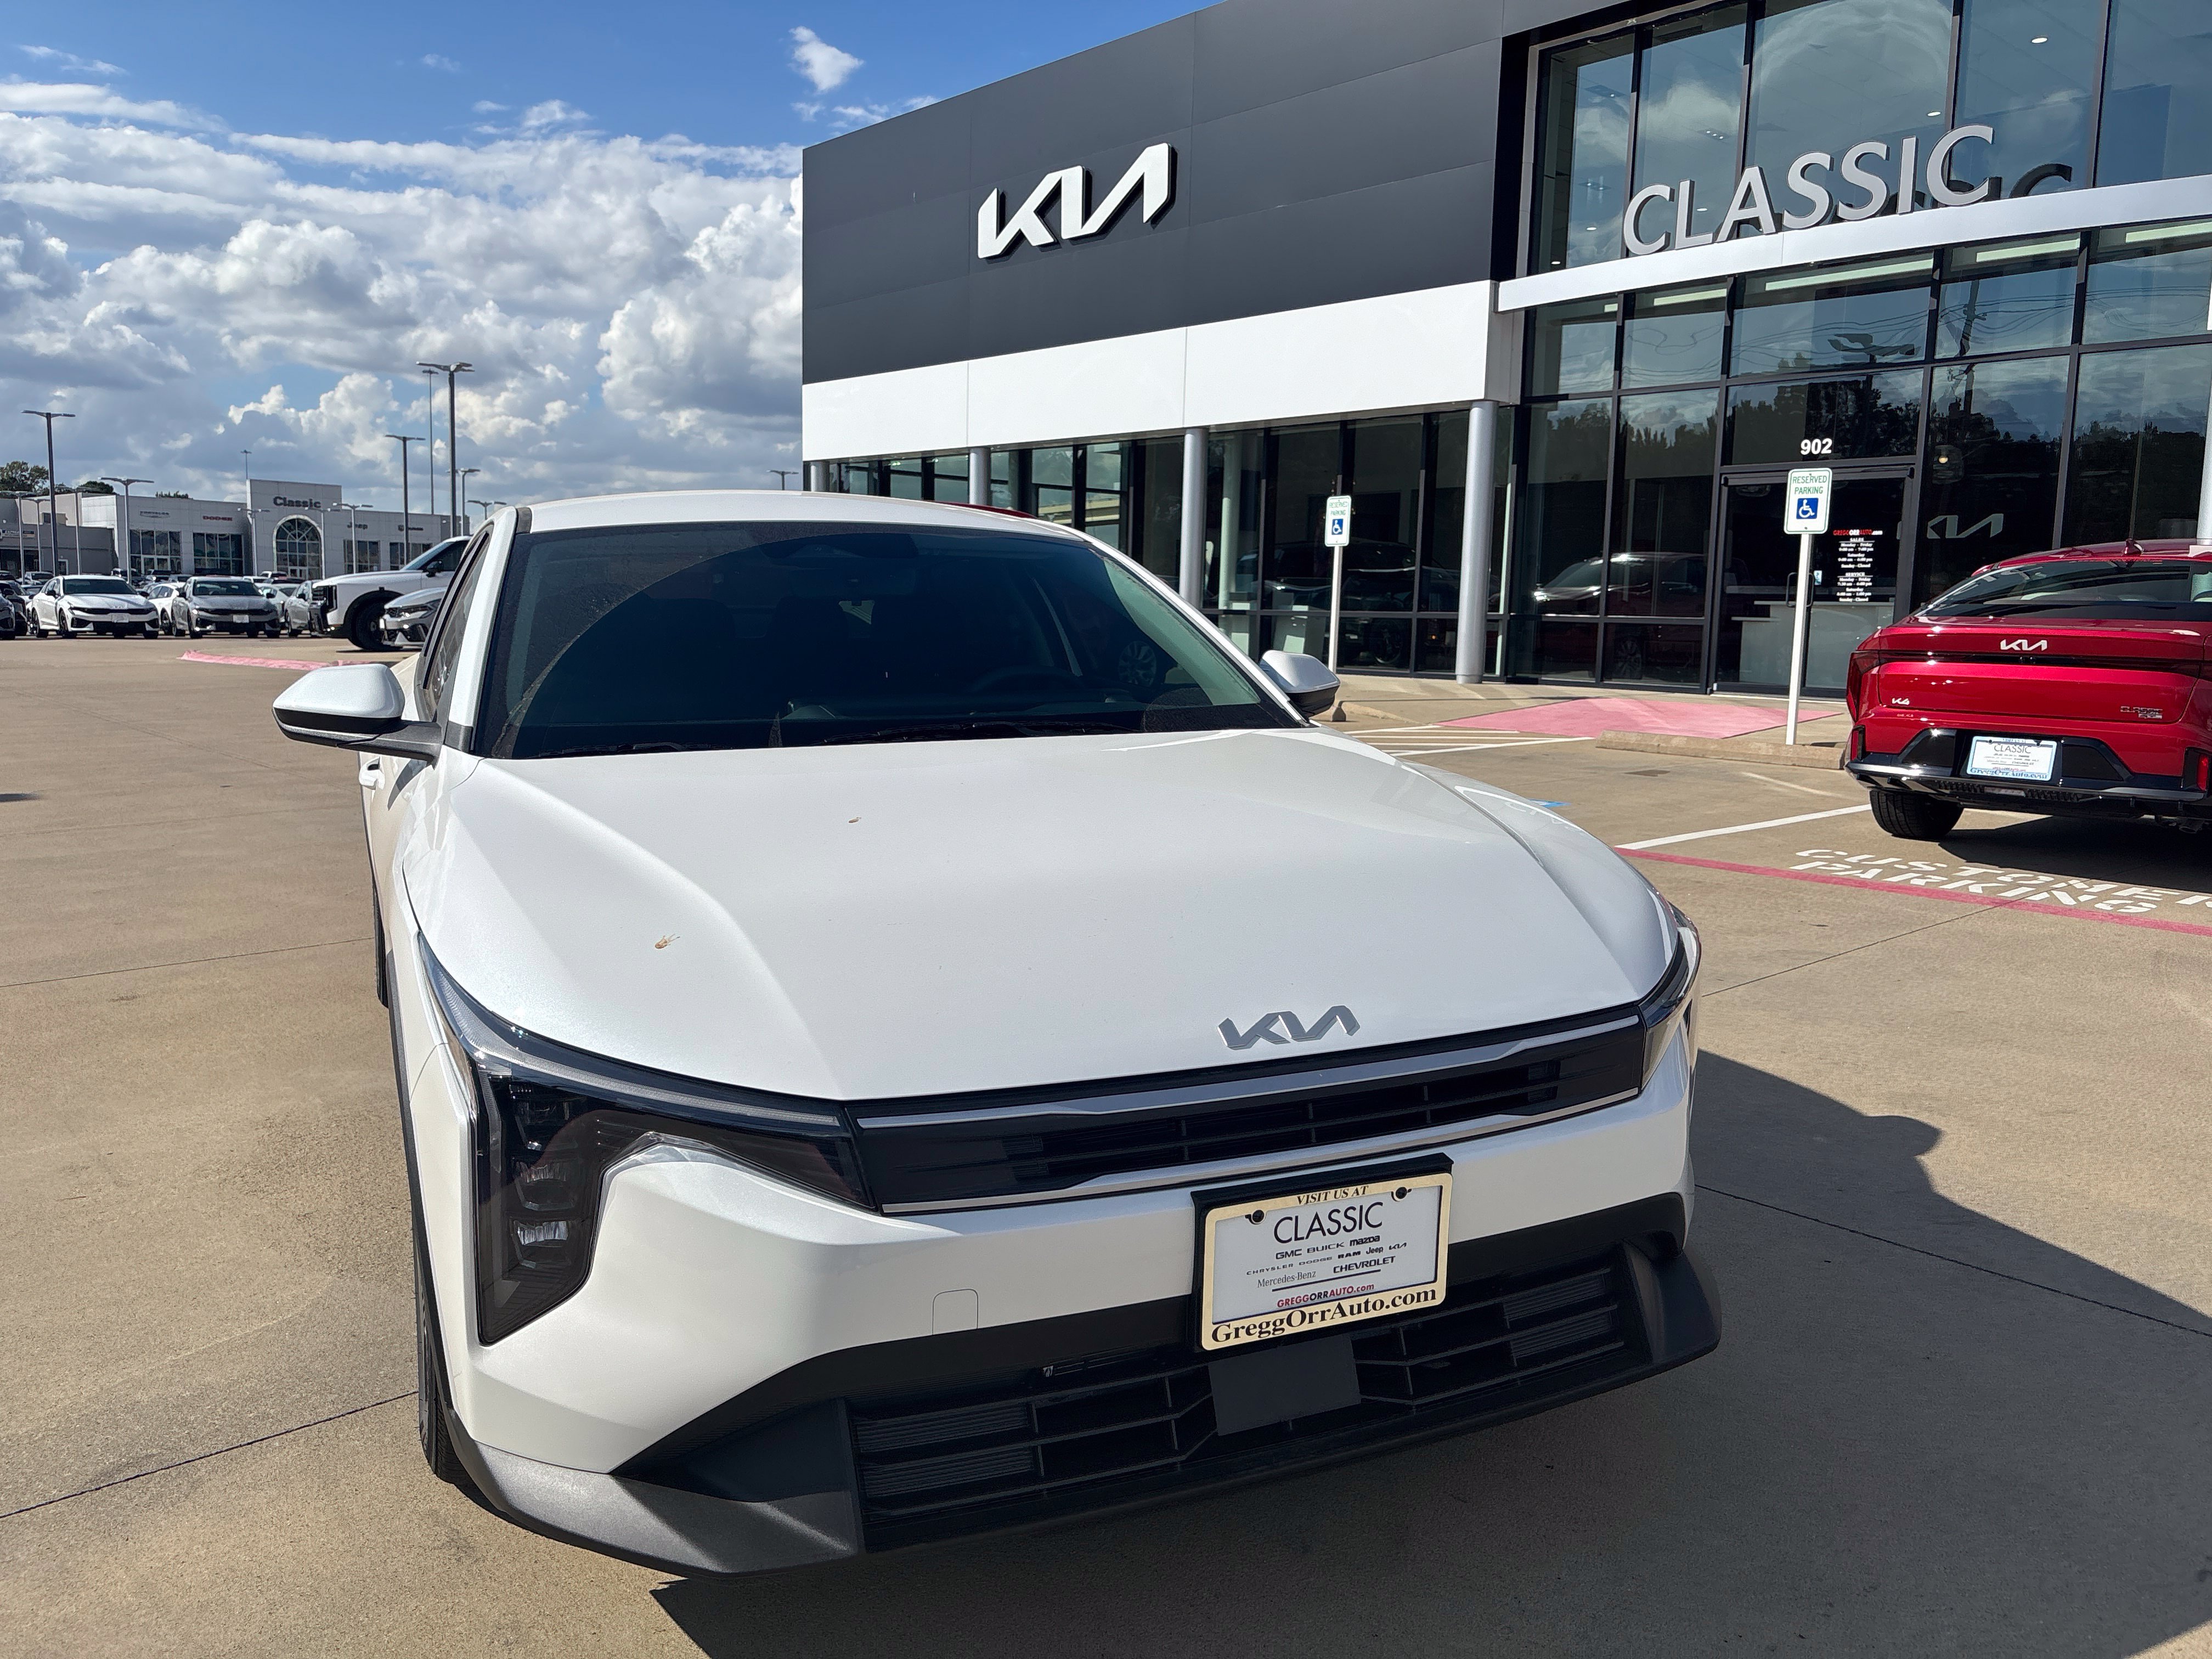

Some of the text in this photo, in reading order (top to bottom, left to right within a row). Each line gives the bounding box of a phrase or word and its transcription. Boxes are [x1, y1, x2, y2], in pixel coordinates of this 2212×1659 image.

[978, 142, 1172, 259] KIA
[1623, 123, 1994, 256] CLASSIC
[1801, 438, 1832, 455] 902
[1792, 475, 1827, 484] RESERVED
[1795, 486, 1824, 494] PARKING
[273, 496, 321, 509] Classic
[2000, 639, 2047, 651] KIA
[1892, 697, 1910, 706] K4
[1994, 744, 2032, 754] CLASSIC
[1788, 861, 2158, 913] PARKING
[1217, 1005, 1361, 1051] KIA
[1296, 1185, 1369, 1205] VISIT US AT
[1273, 1201, 1384, 1244] CLASSIC
[1246, 1242, 1407, 1276] CHRYSLER DODGE RAM Jeep KIA
[1276, 1235, 1380, 1260] GMC BUICK mazda
[1257, 1256, 1396, 1288] Mercedes-Benz CHEVROLET
[1277, 1284, 1375, 1308] GREGGORRAUTO.com
[1211, 1289, 1437, 1342] GreggOrrAuto.com
